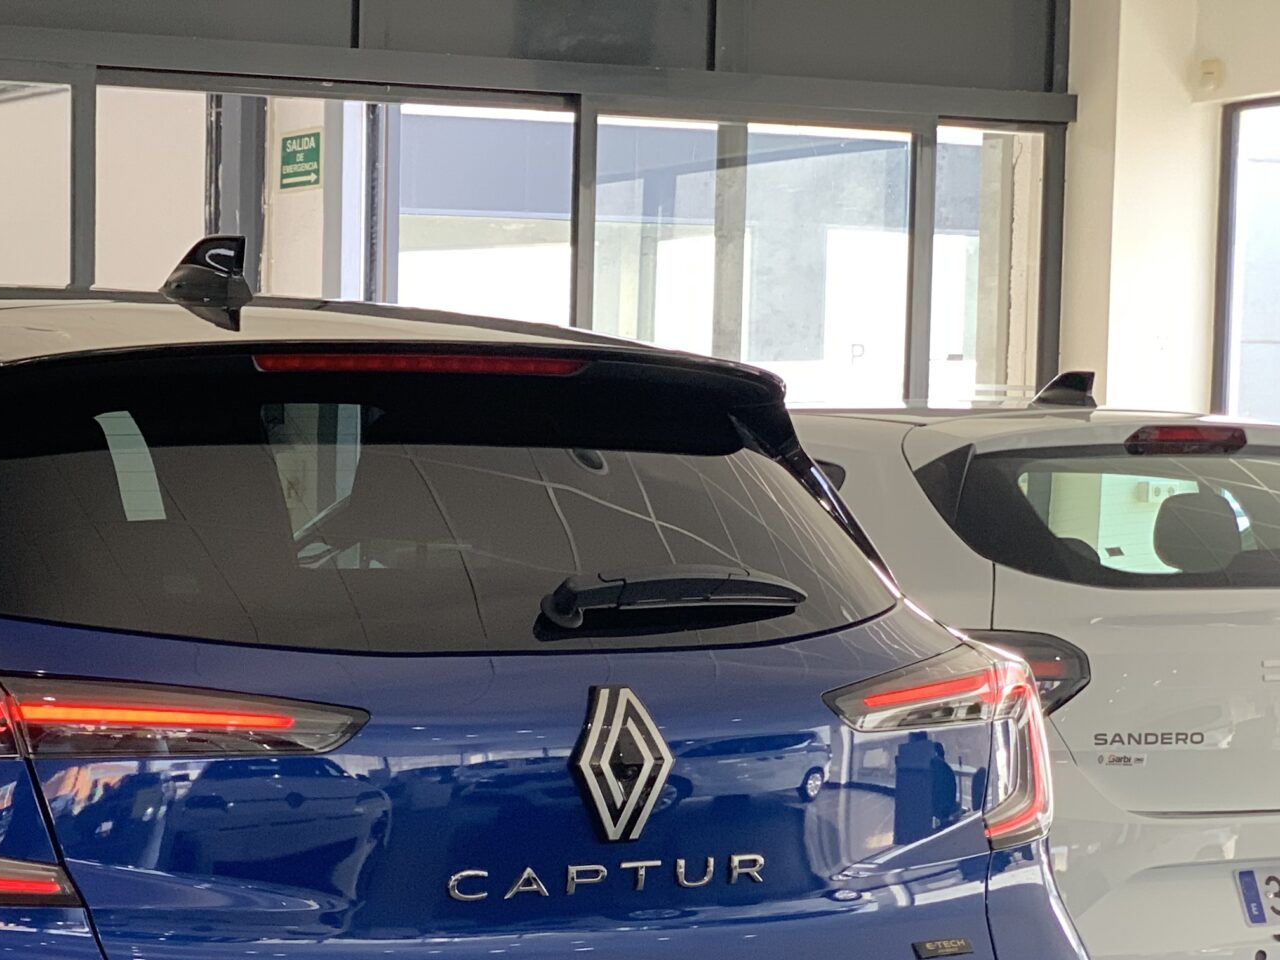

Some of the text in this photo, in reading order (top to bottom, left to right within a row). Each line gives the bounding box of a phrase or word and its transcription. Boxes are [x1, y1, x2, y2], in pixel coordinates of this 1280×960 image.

[286, 136, 316, 153] SALIDA
[296, 153, 304, 162] DE
[282, 161, 318, 174] EMERGENCIA
[1093, 732, 1205, 746] SANDERO
[447, 853, 765, 902] CAPTUR
